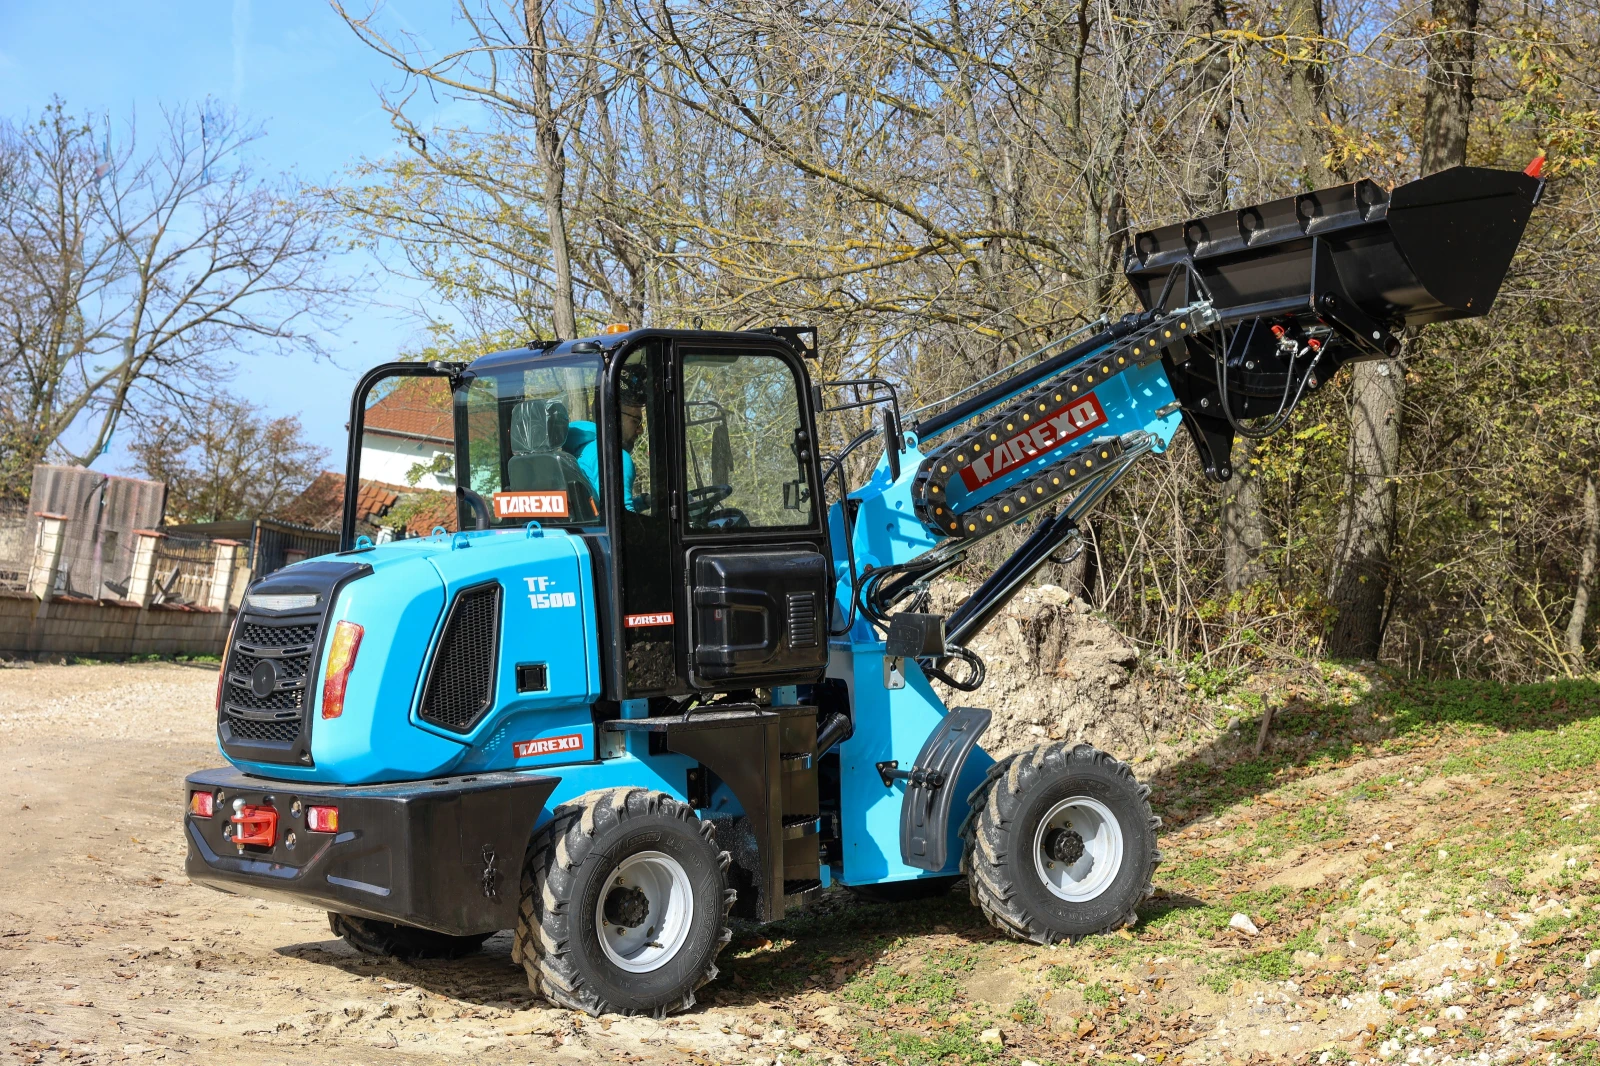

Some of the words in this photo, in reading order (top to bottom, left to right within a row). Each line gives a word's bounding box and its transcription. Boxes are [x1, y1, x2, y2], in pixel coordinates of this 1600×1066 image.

[963, 400, 1099, 484] TAREXO
[495, 495, 565, 515] TAREXO
[523, 576, 556, 592] TF-
[527, 592, 576, 609] 1500
[626, 614, 672, 627] TAREXO
[514, 736, 580, 756] TAREXO
